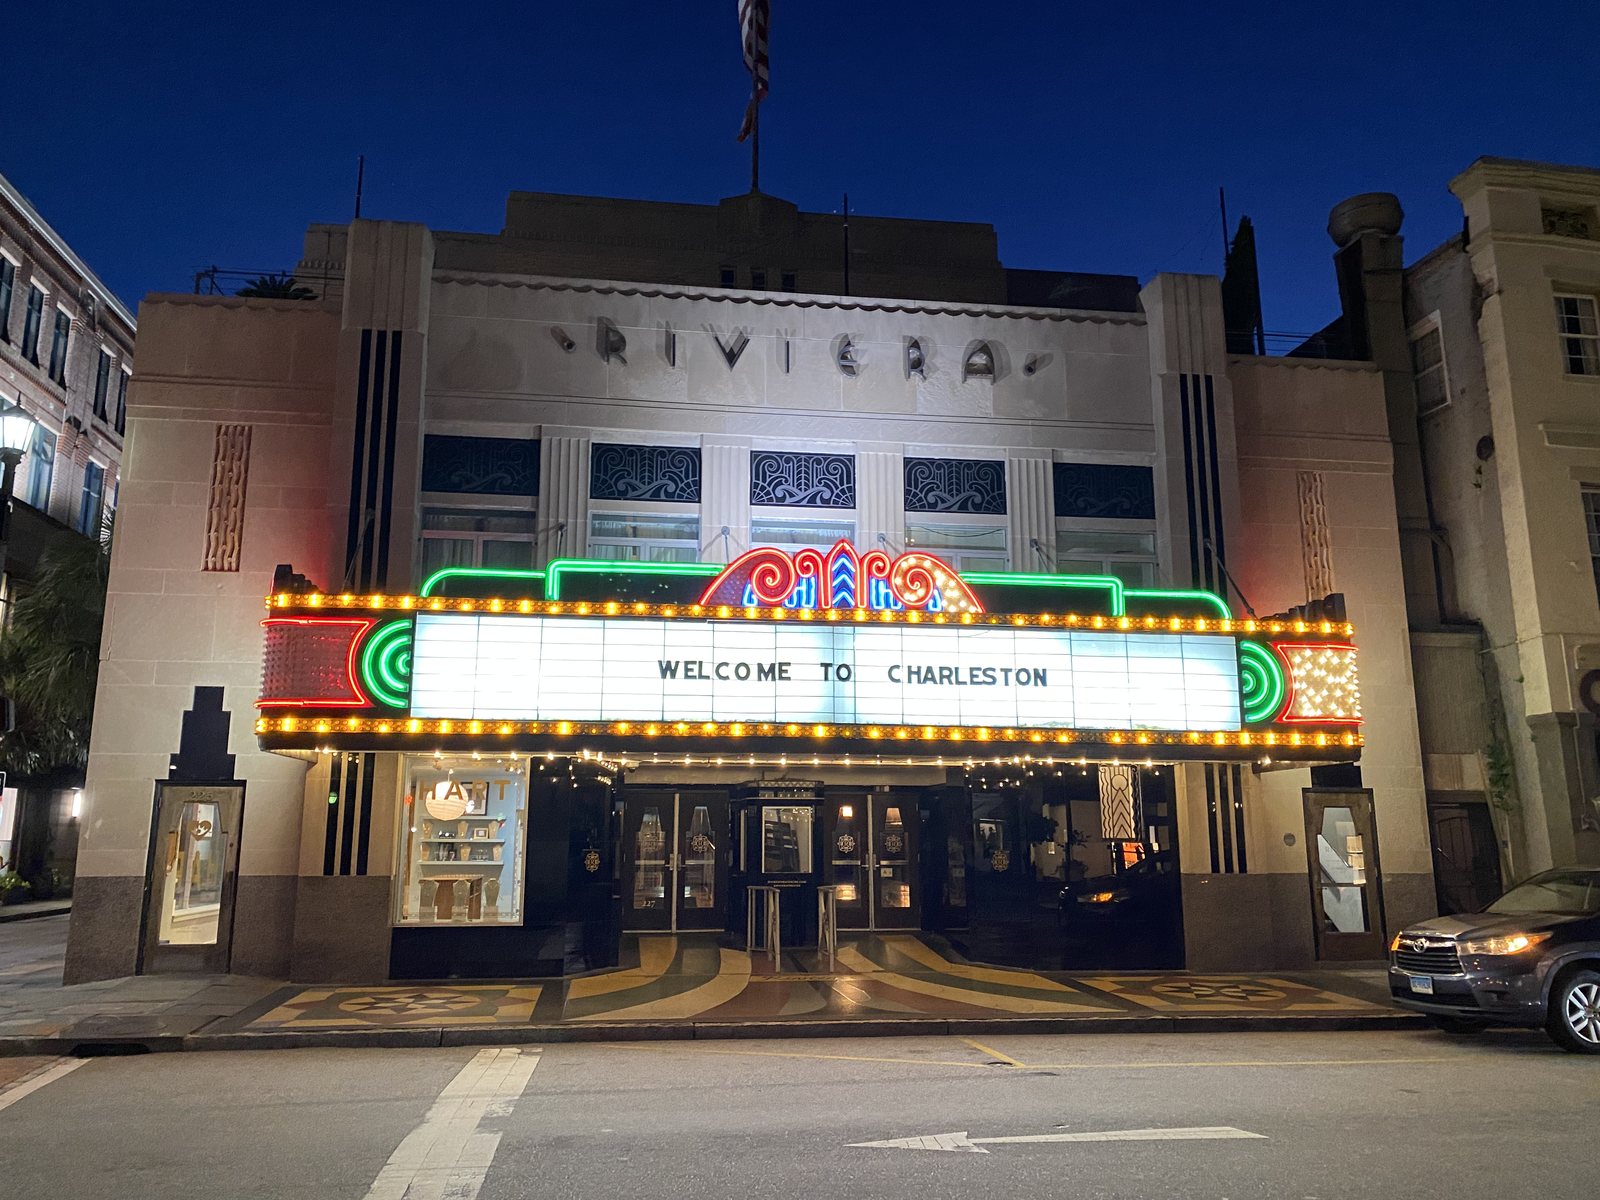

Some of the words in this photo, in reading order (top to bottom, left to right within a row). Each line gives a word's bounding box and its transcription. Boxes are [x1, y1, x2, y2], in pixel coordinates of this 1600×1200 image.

[597, 315, 996, 386] RIVIERA
[658, 660, 792, 682] WELCOME
[820, 662, 852, 682] TO
[887, 664, 1048, 687] CHARLESTON
[419, 779, 512, 801] HART
